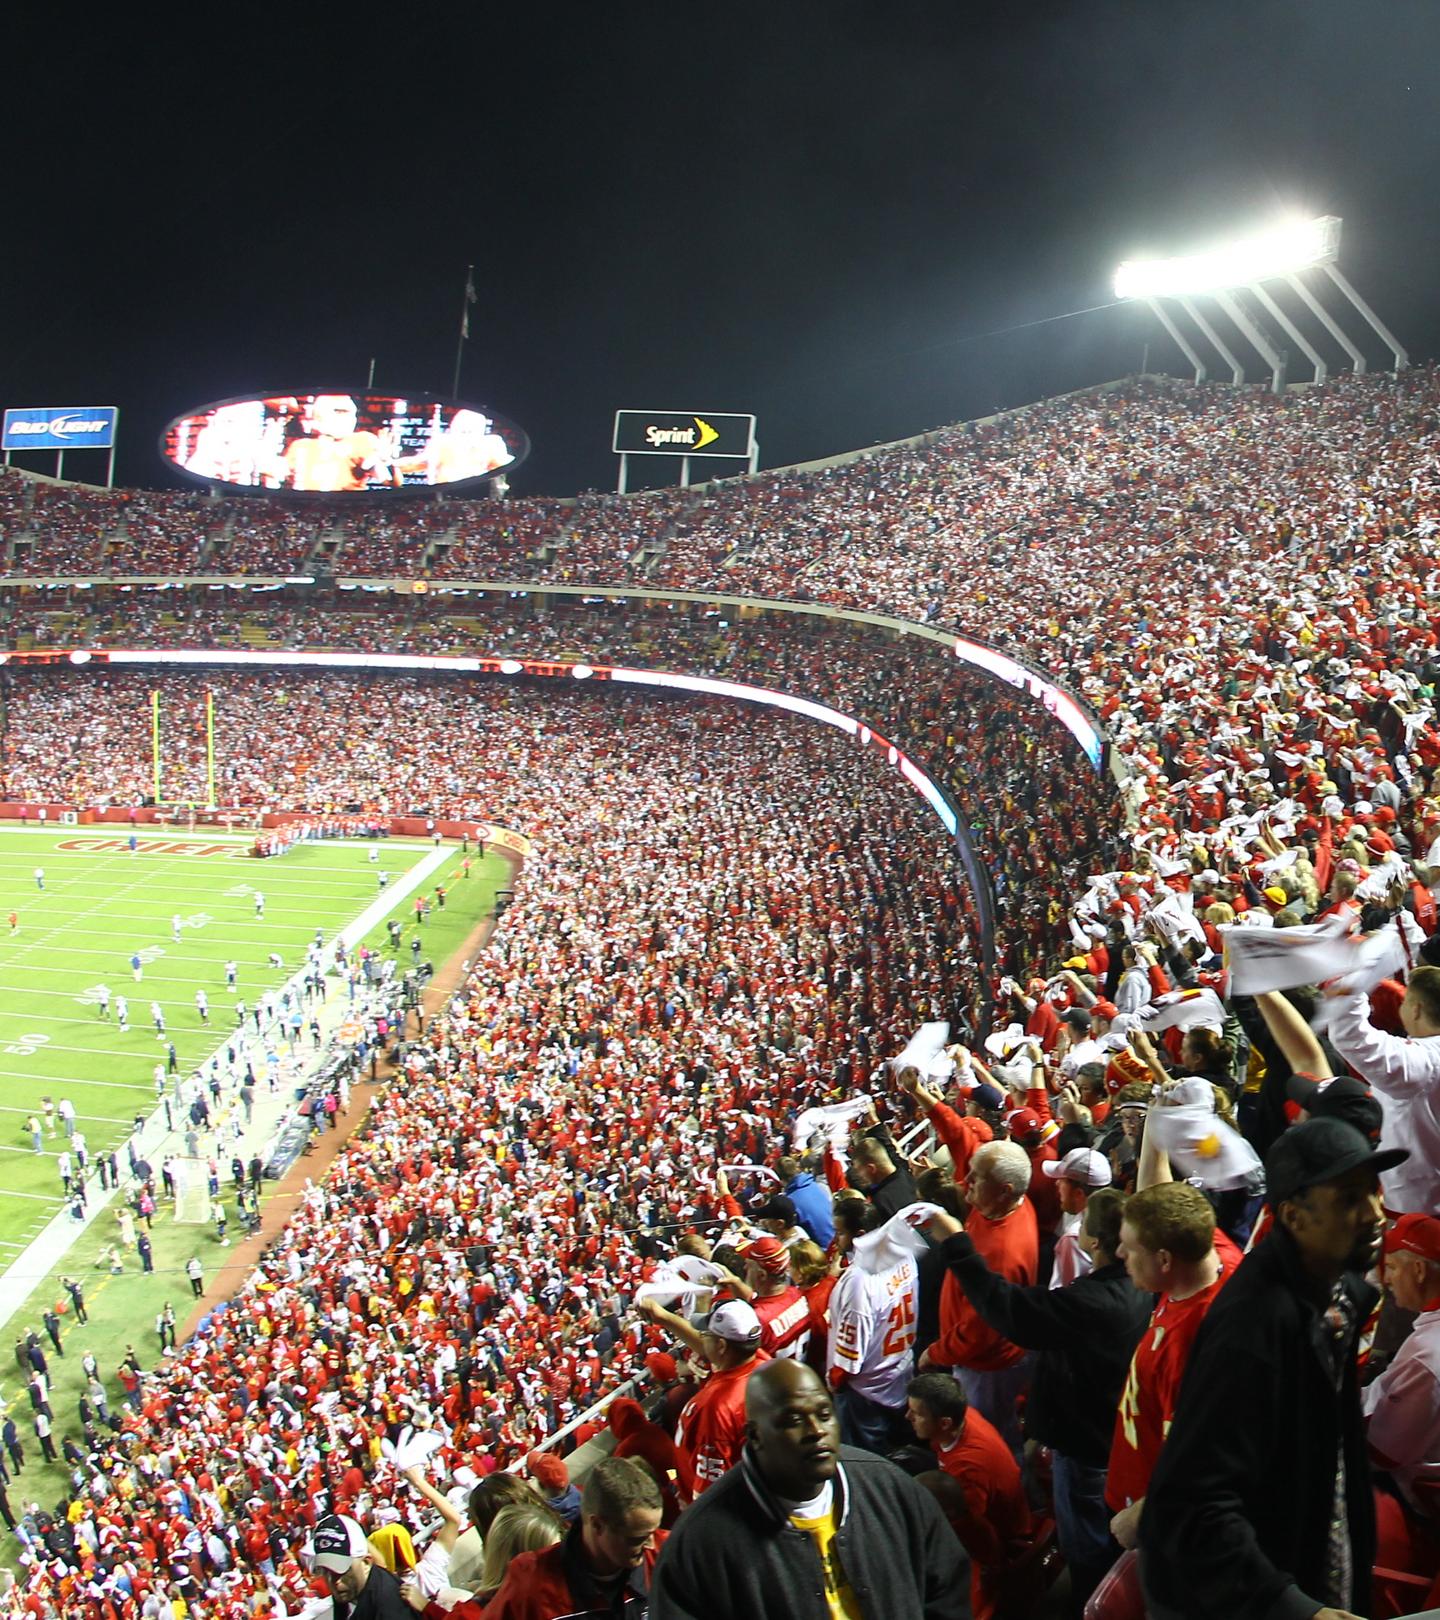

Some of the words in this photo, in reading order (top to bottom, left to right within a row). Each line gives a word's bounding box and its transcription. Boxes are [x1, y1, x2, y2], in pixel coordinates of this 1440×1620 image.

[8, 421, 50, 435] BUD
[56, 420, 109, 433] LIGHT
[645, 425, 696, 447] Sprint
[3, 1033, 51, 1056] 50
[696, 1454, 725, 1481] 25
